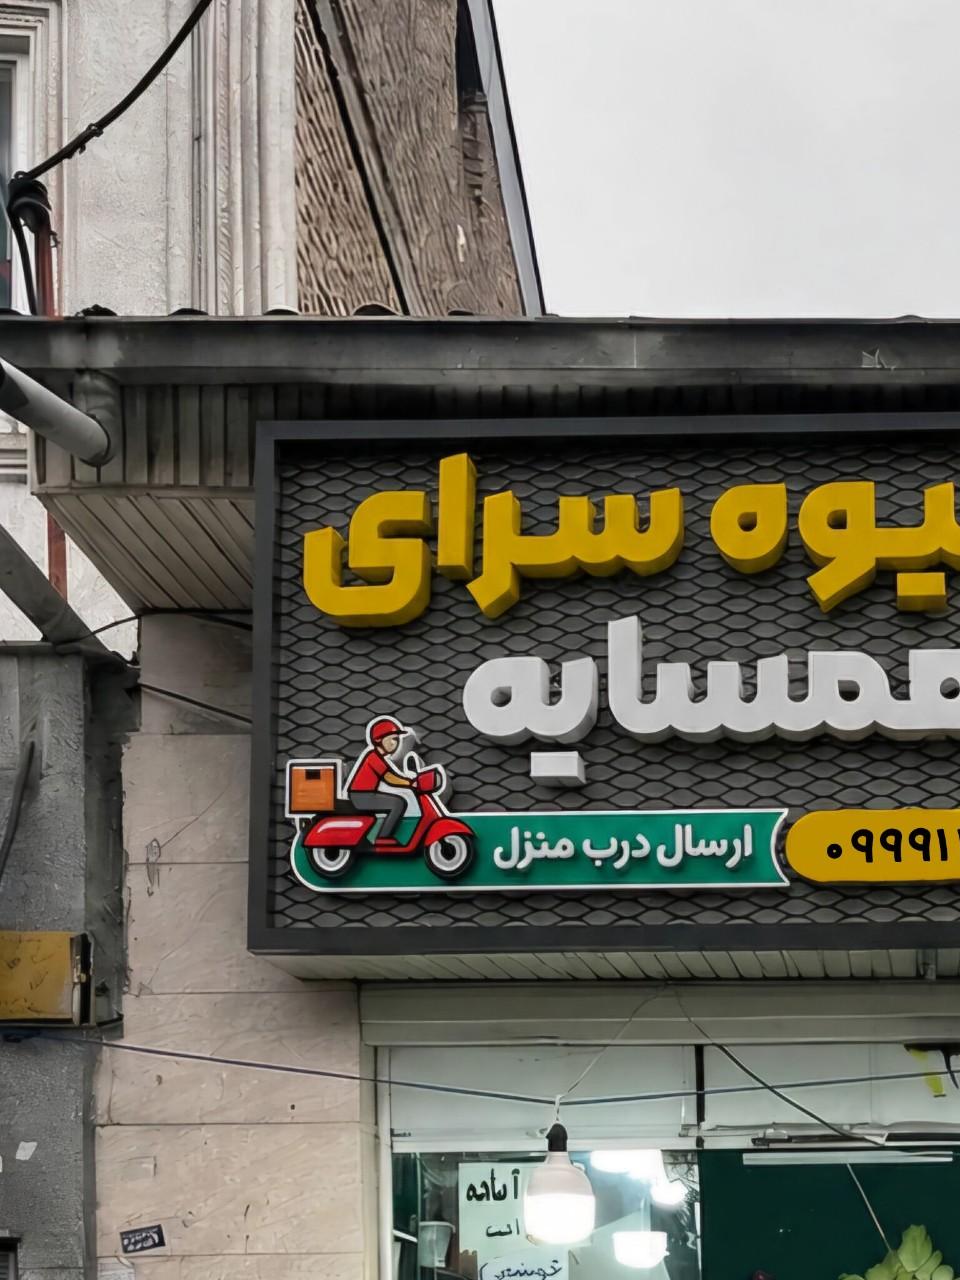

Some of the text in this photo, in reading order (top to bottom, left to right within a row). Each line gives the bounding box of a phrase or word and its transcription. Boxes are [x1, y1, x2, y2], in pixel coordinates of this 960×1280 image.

[303, 453, 685, 627] سرای
[493, 823, 753, 870] ارسال درب منزل
